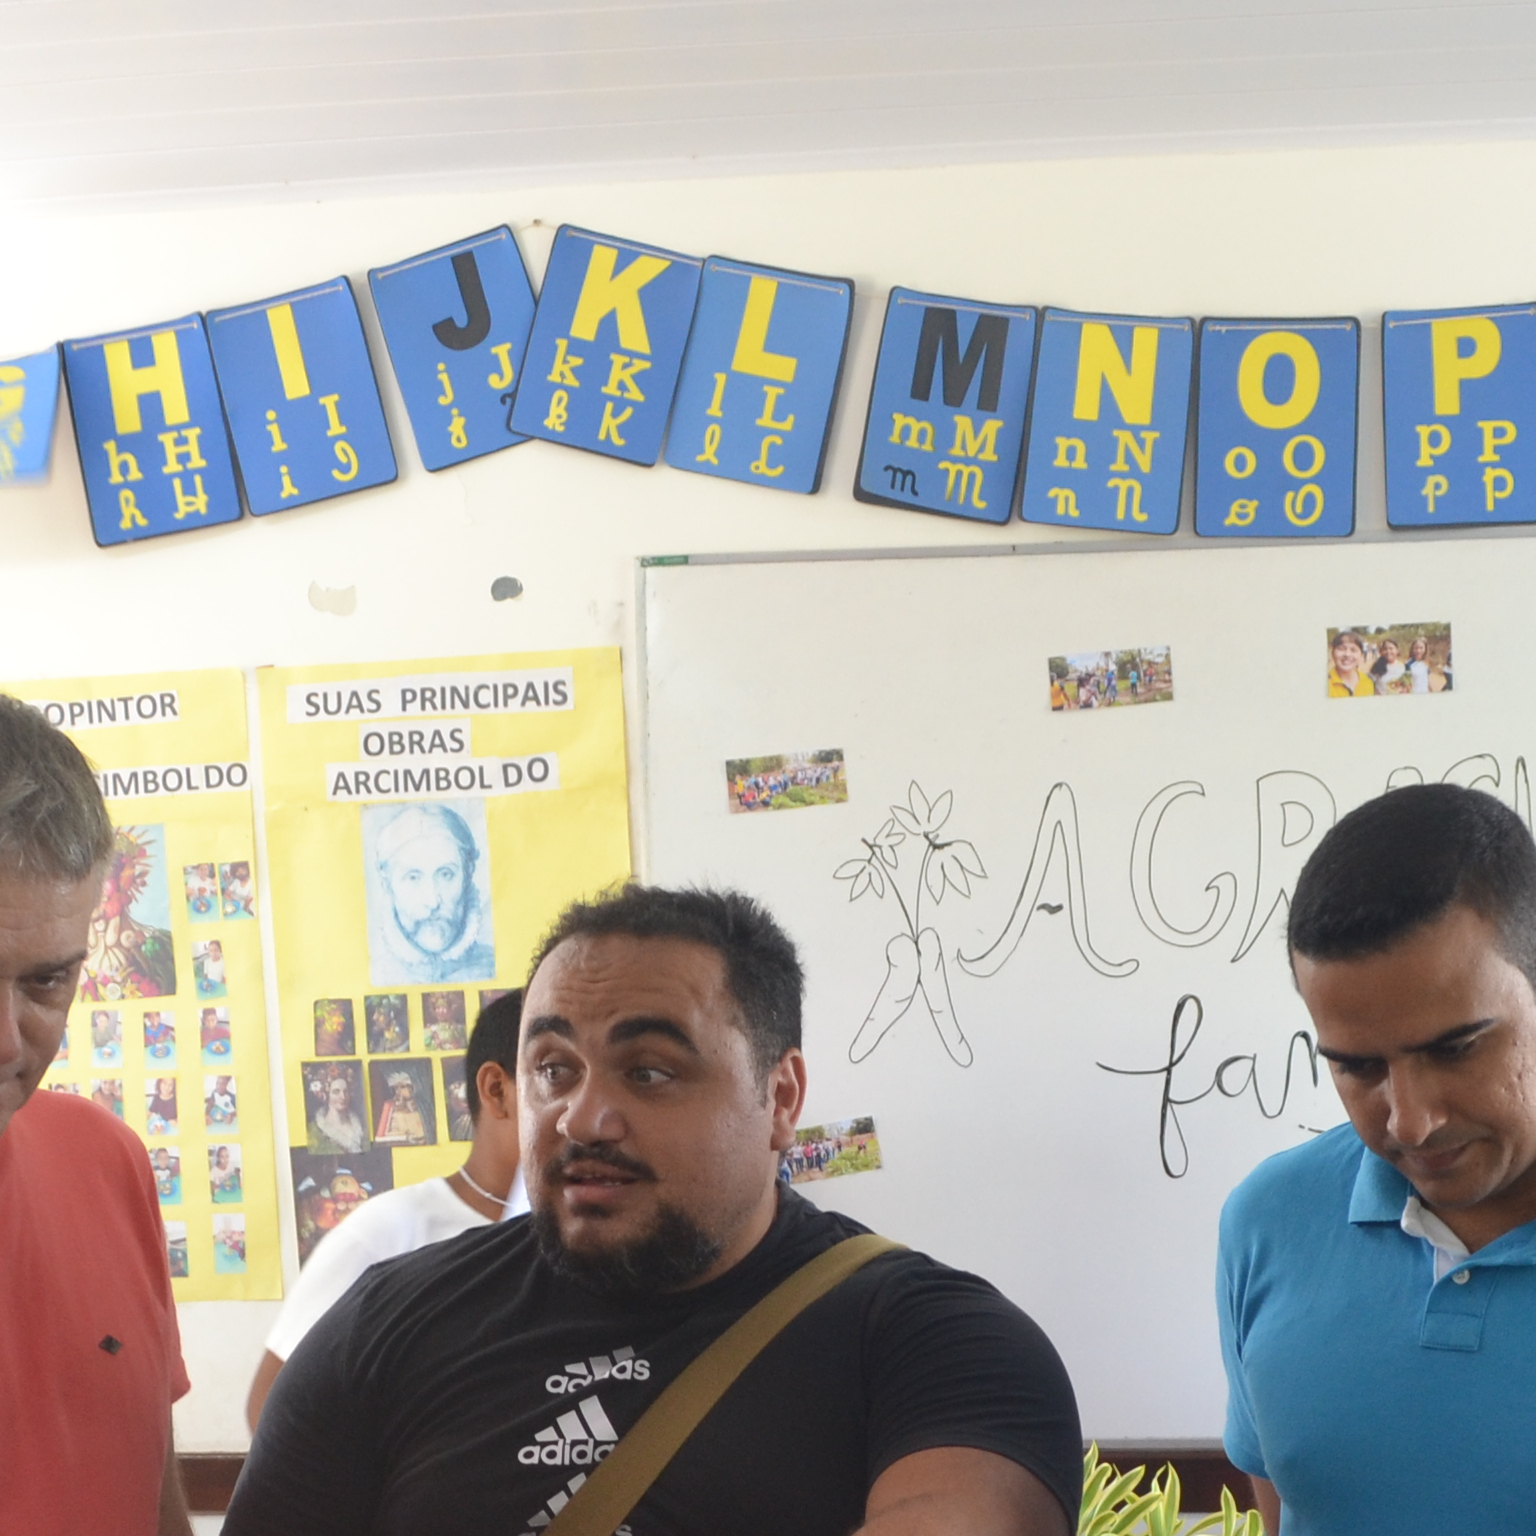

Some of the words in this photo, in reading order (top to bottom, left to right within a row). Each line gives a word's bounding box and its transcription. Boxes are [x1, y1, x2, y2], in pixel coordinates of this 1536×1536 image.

[431, 249, 492, 352] J
[570, 244, 672, 355] K
[266, 302, 312, 400] I
[731, 275, 798, 383] L
[103, 329, 190, 435] H
[437, 363, 454, 406] j
[488, 342, 514, 390] J
[547, 338, 584, 387] k
[601, 353, 652, 402] K
[909, 306, 1010, 412] M
[1072, 320, 1160, 426] N
[1237, 330, 1321, 430] O
[1430, 315, 1502, 416] P
[265, 409, 289, 452] i
[319, 393, 348, 437] I
[544, 389, 569, 432] k
[706, 372, 728, 418] l
[756, 385, 795, 432] L
[447, 407, 469, 449] j
[695, 423, 722, 465] l
[889, 412, 935, 452] m
[948, 414, 1004, 462] M
[1053, 436, 1088, 469] n
[1110, 429, 1160, 474] N
[1416, 423, 1452, 467] p
[1477, 420, 1518, 463] P
[104, 440, 143, 484] h
[158, 427, 207, 474] H
[1224, 446, 1257, 479] o
[1282, 434, 1326, 479] O
[279, 465, 301, 499] i
[882, 464, 919, 496] m
[1048, 487, 1080, 518] n
[1420, 473, 1449, 513] p
[119, 489, 148, 530] h
[1224, 497, 1259, 527] o
[305, 688, 382, 717] SUAS
[400, 679, 569, 712] PRINCIPAIS
[363, 728, 465, 757] OBRAS
[94, 762, 248, 797] IMBOLDO
[517, 1438, 616, 1466] adida
